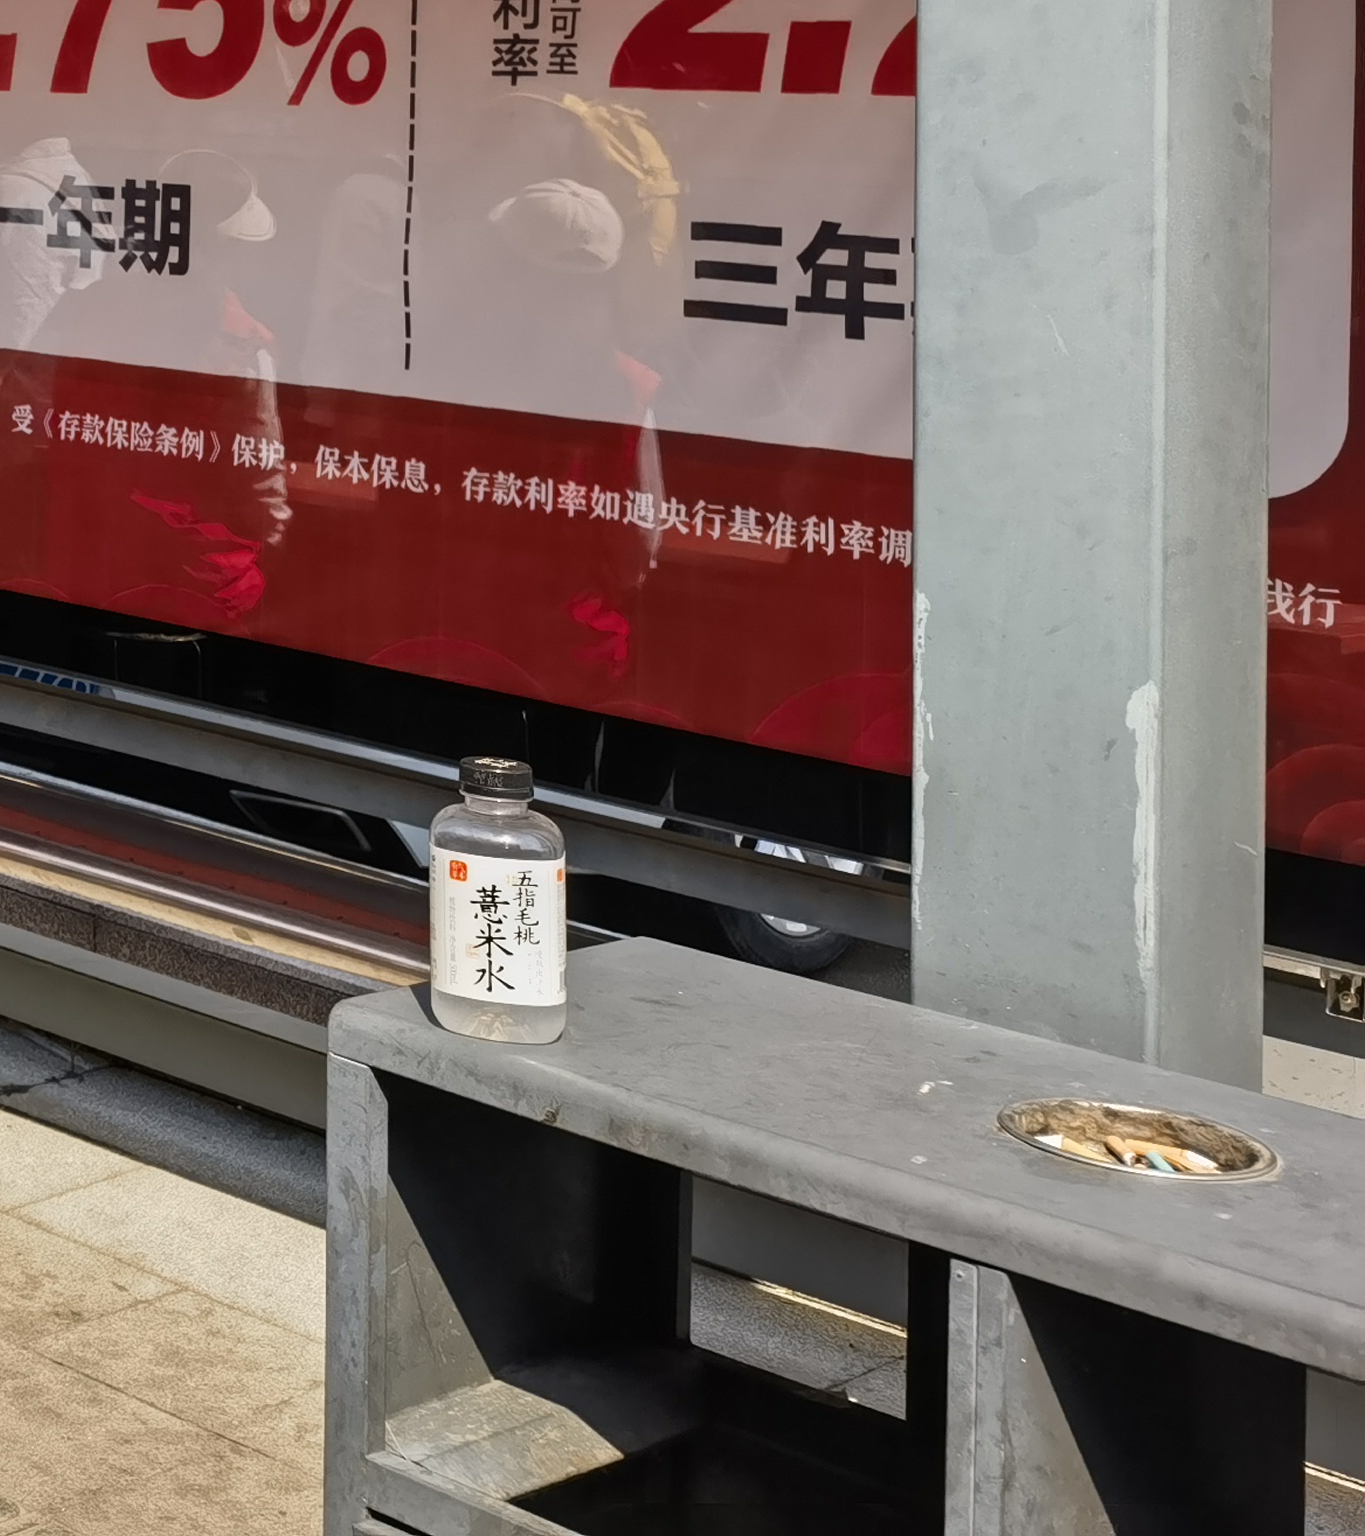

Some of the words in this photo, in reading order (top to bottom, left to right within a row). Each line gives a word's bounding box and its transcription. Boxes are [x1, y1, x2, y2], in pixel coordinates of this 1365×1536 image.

[682, 219, 917, 341] 三年
[469, 884, 516, 993] 薏米水
[512, 870, 541, 946] 五指毛桃
